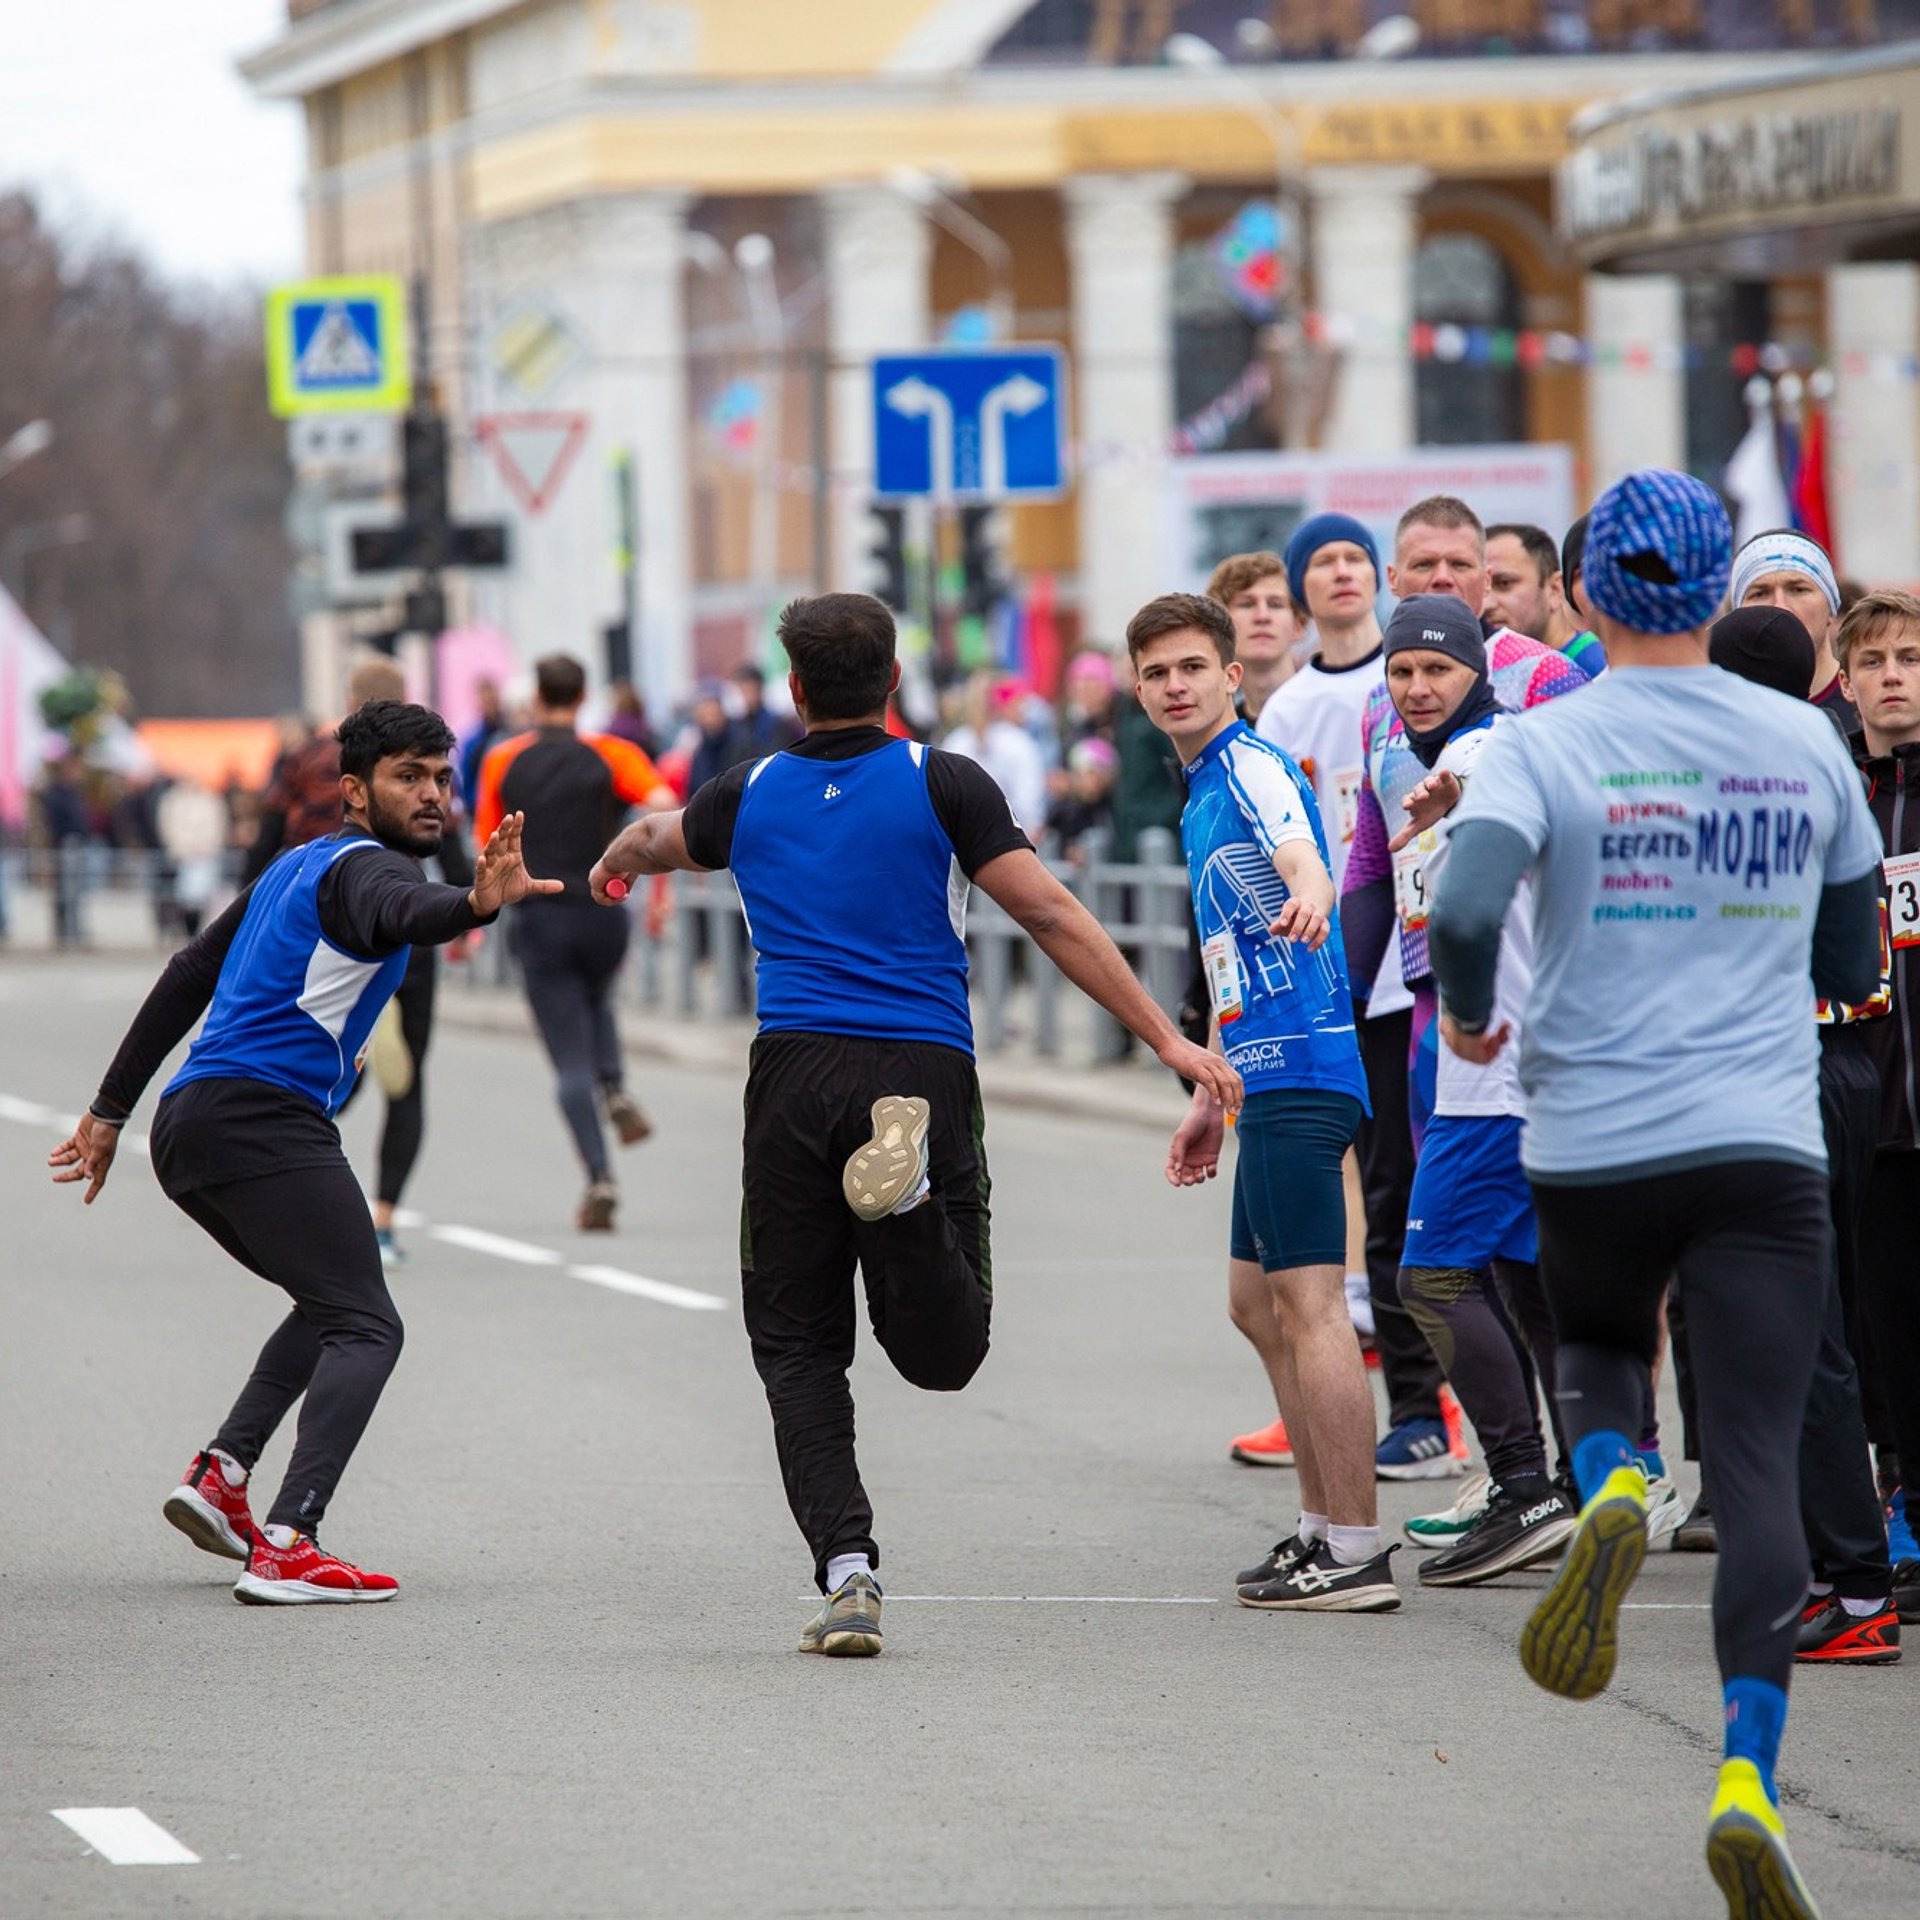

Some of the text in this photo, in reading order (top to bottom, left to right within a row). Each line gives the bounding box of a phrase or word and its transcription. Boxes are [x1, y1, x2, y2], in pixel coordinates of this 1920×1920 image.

[1422, 629, 1446, 642] RW
[1719, 777, 1809, 796] общаться
[1608, 802, 1686, 824] дружить
[1600, 807, 1814, 890] БЕГАТЬ МОДНО
[1603, 871, 1673, 890] любить
[1593, 902, 1697, 924] улыбаться
[1519, 1497, 1564, 1527] HOKA
